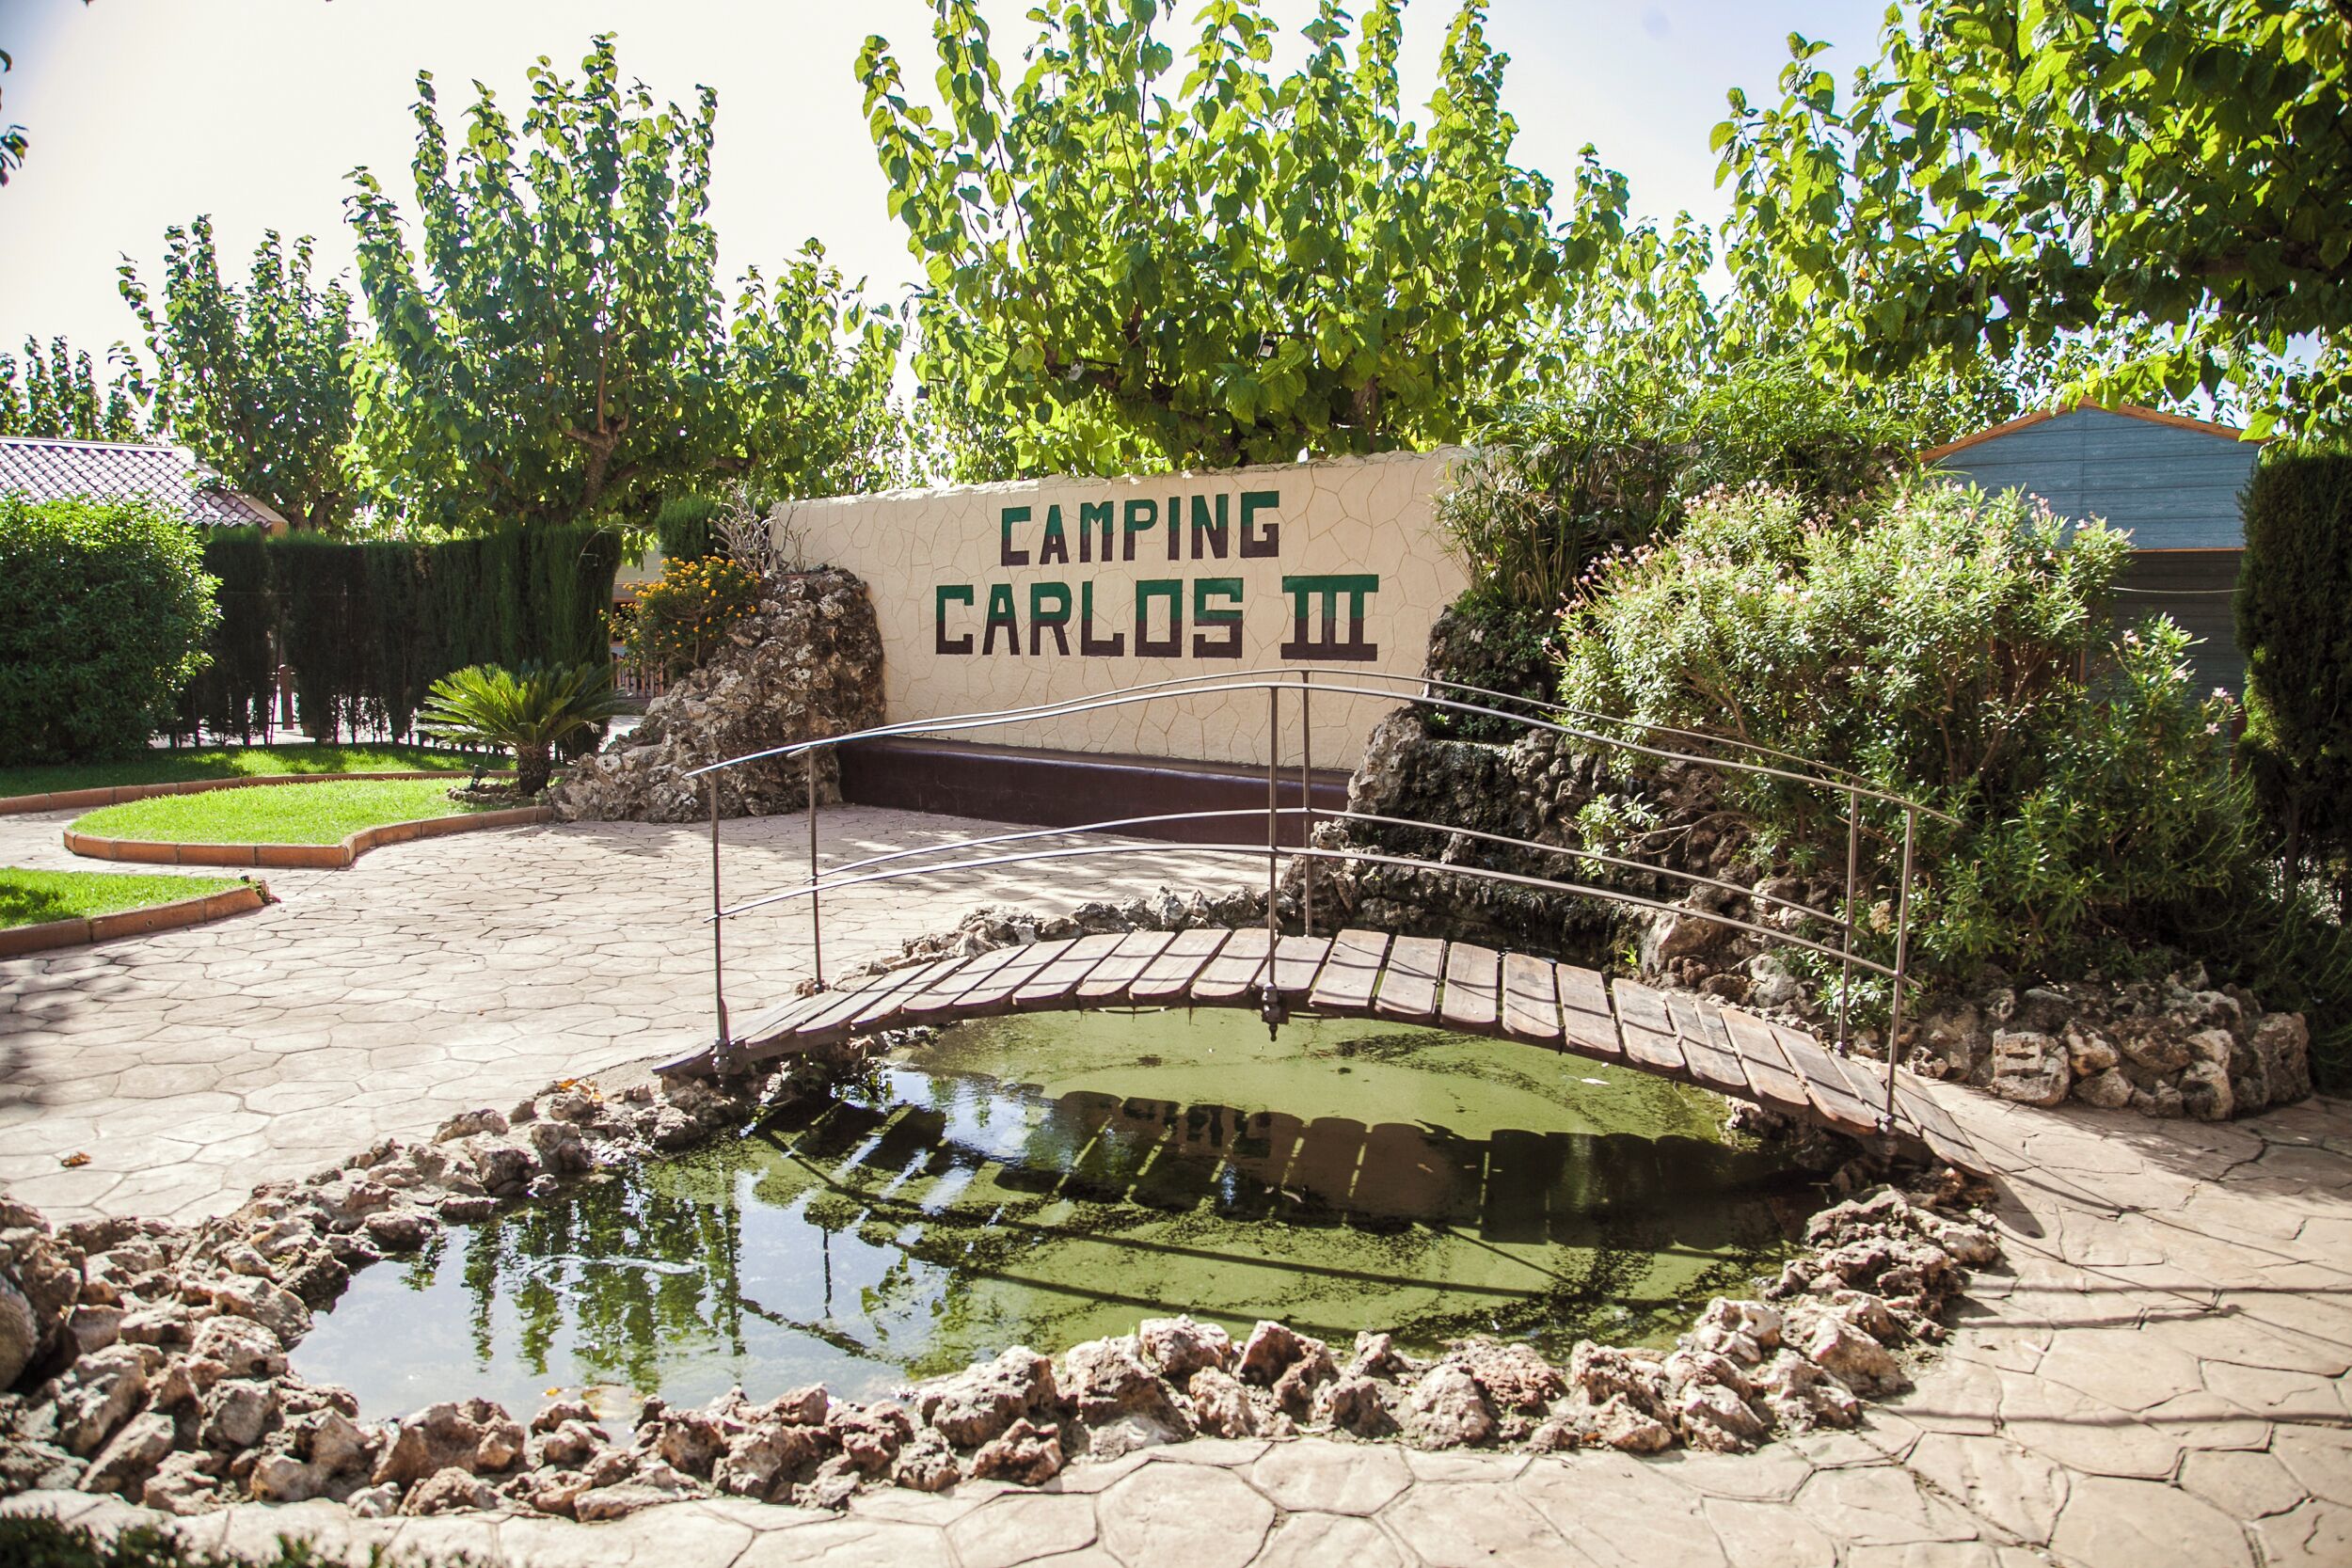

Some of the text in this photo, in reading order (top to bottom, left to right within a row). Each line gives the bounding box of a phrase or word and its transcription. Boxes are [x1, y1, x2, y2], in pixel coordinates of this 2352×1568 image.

[1001, 490, 1279, 566] CAMPING
[936, 575, 1379, 660] CARLOS III
